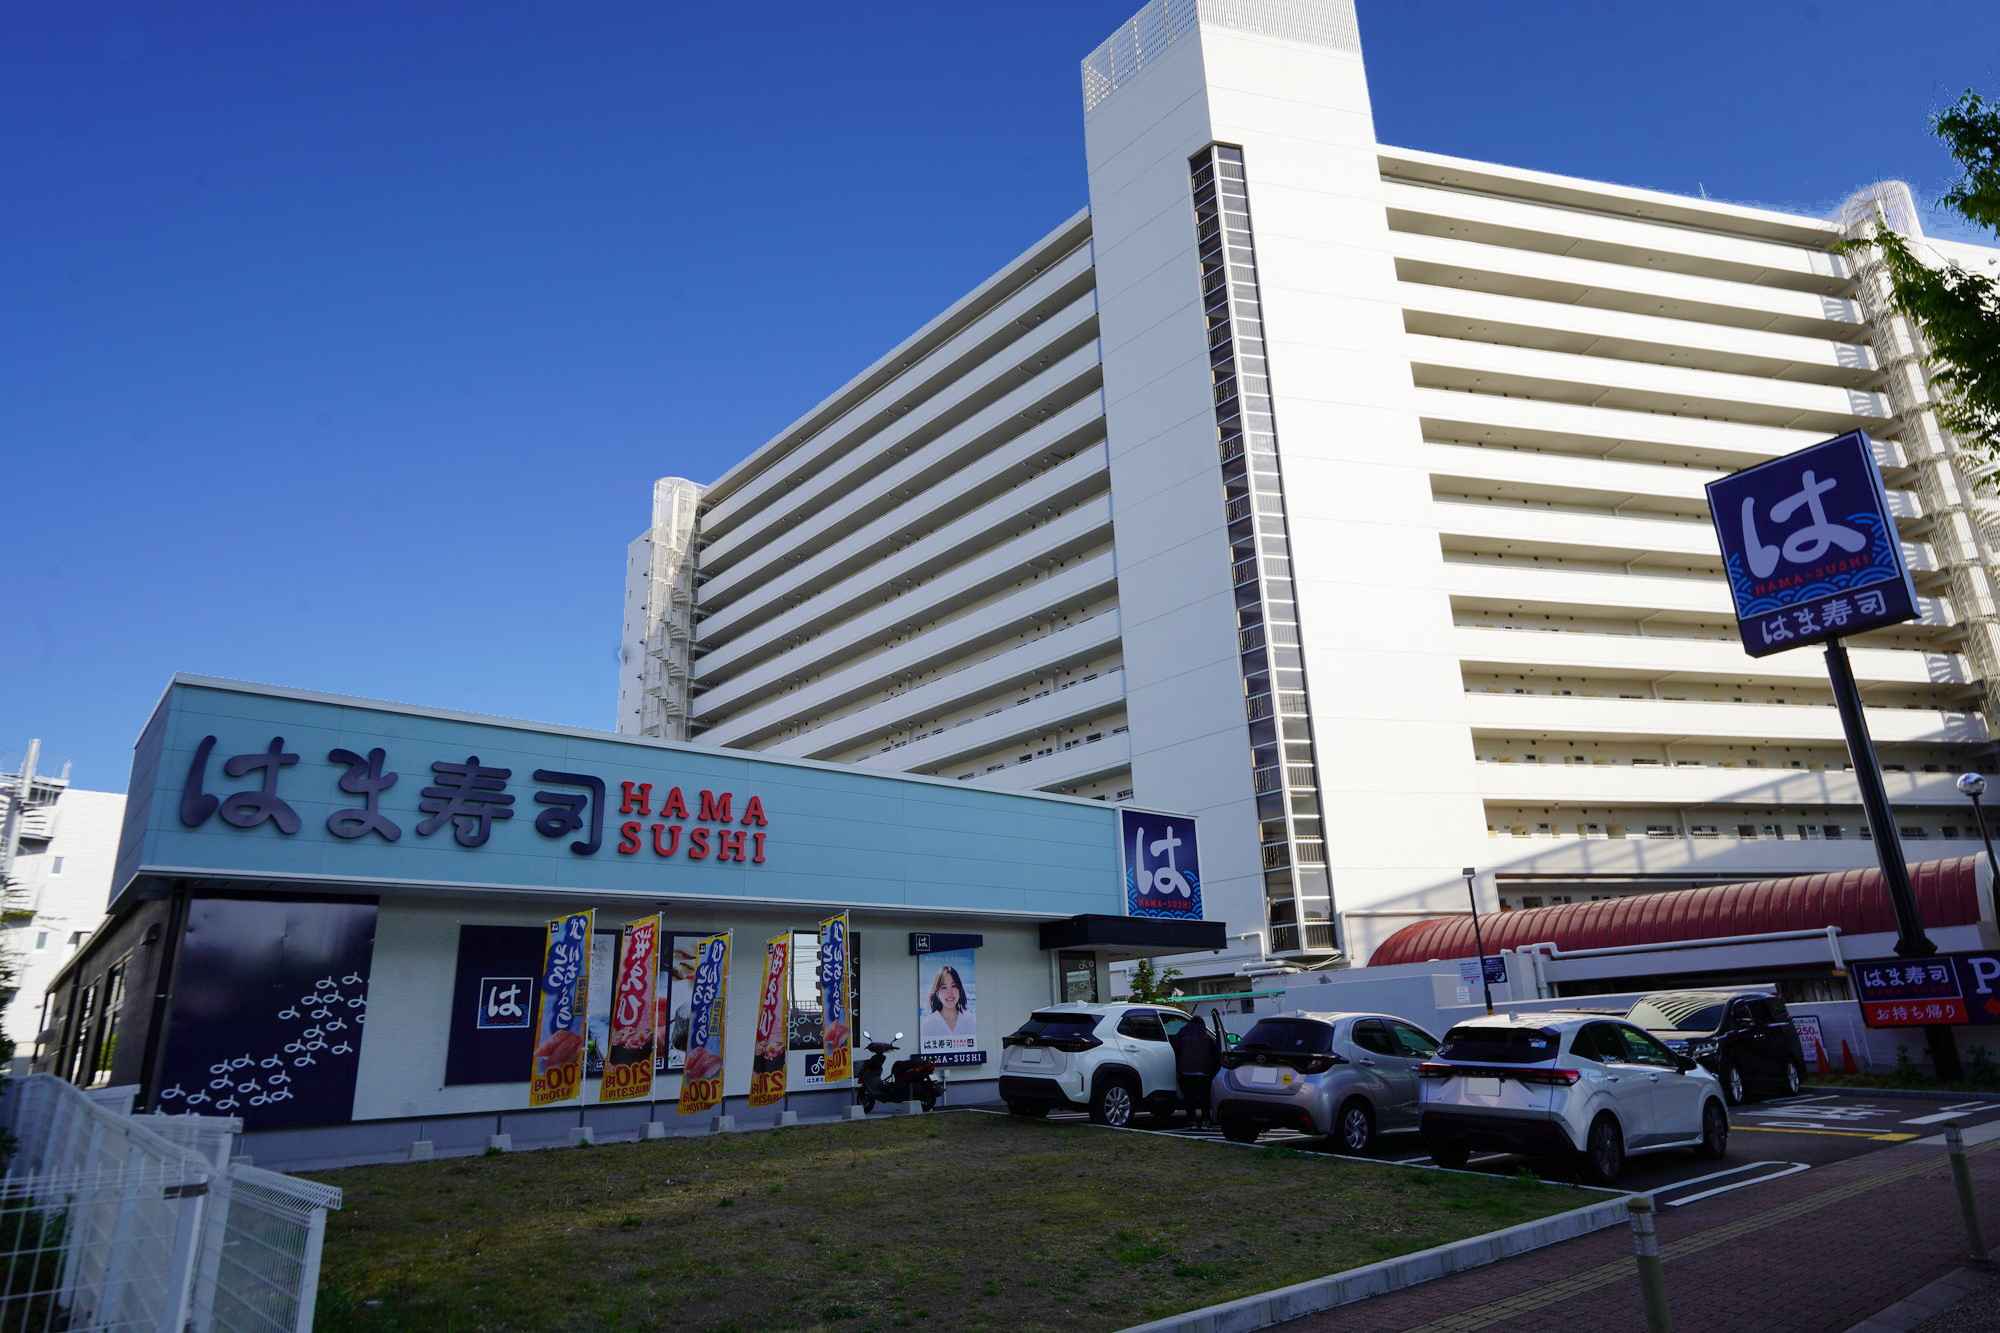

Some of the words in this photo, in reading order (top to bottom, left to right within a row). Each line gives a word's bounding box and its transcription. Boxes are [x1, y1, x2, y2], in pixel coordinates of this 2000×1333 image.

[1741, 469, 1867, 579] は
[1754, 553, 1870, 595] HAMA-SUSHI
[1761, 588, 1886, 644] はま寿司
[180, 734, 606, 856] はま寿司
[618, 780, 769, 826] HAMA
[617, 820, 768, 864] SUSHI
[1135, 824, 1191, 899] は
[1137, 897, 1192, 910] HAMA-SUSHI
[1864, 963, 1951, 988] はま寿司
[1967, 956, 2000, 994] P
[487, 983, 523, 1018] は
[1875, 1003, 1956, 1022] お持ち帰り
[923, 1039, 953, 1050] はま寿司
